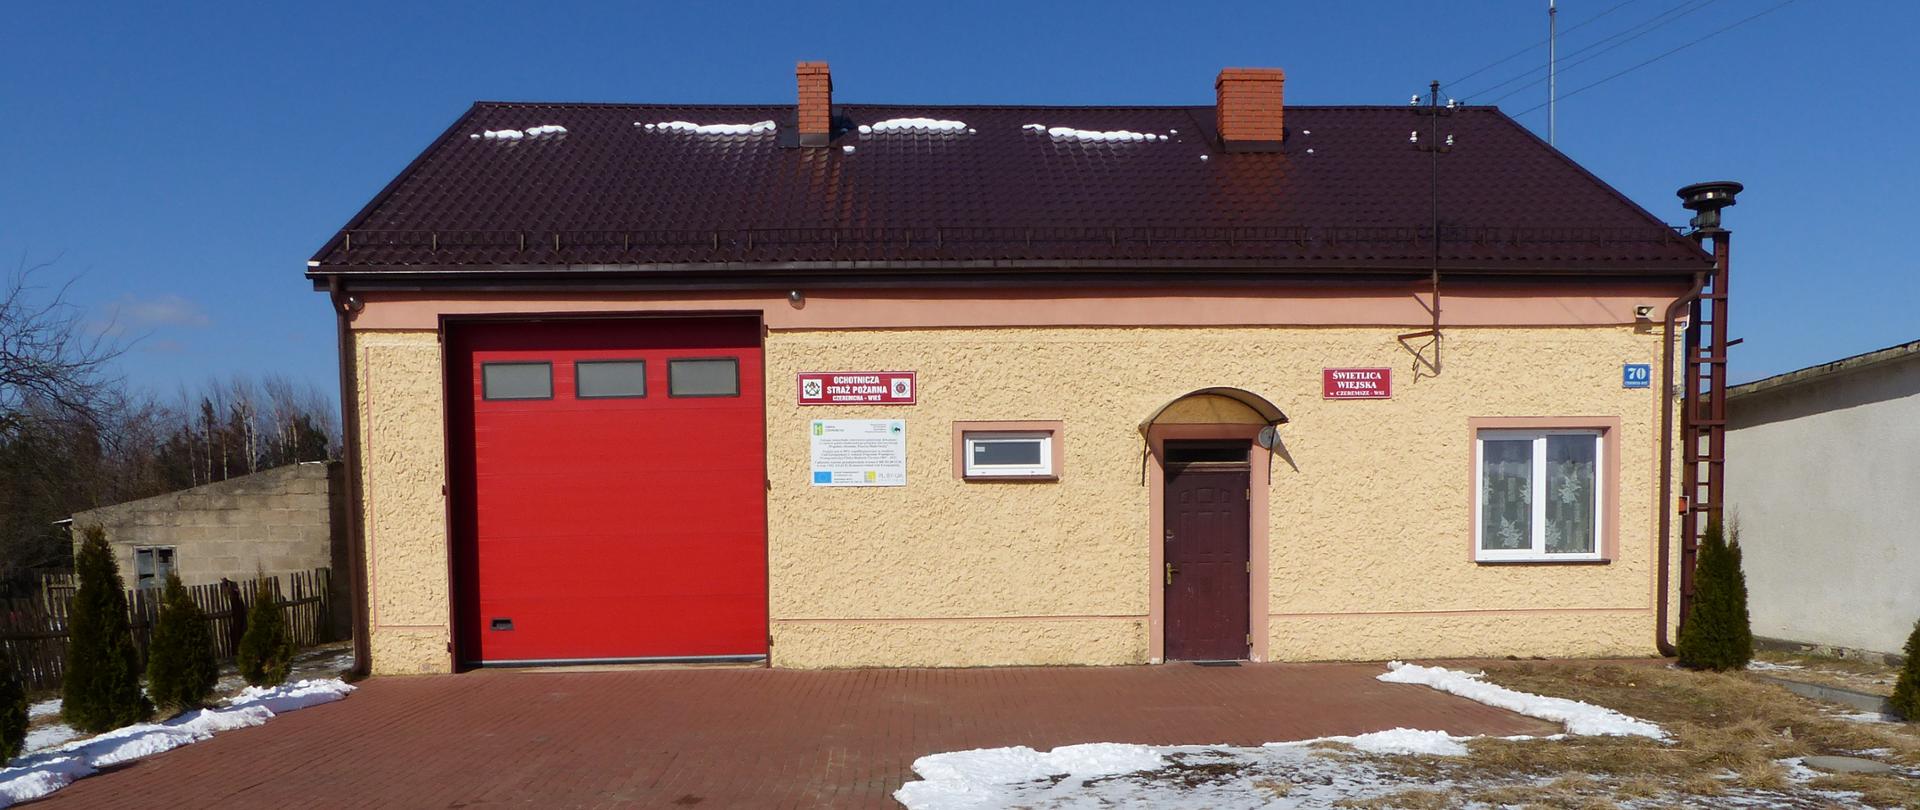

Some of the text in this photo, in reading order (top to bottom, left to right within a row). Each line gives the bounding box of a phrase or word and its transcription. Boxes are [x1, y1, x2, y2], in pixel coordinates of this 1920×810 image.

[1332, 370, 1382, 380] ŚWIETLICA
[1628, 368, 1646, 380] 70
[834, 376, 880, 384] OCHOTNICZA
[826, 385, 888, 394] STRAŻ POŻARNA
